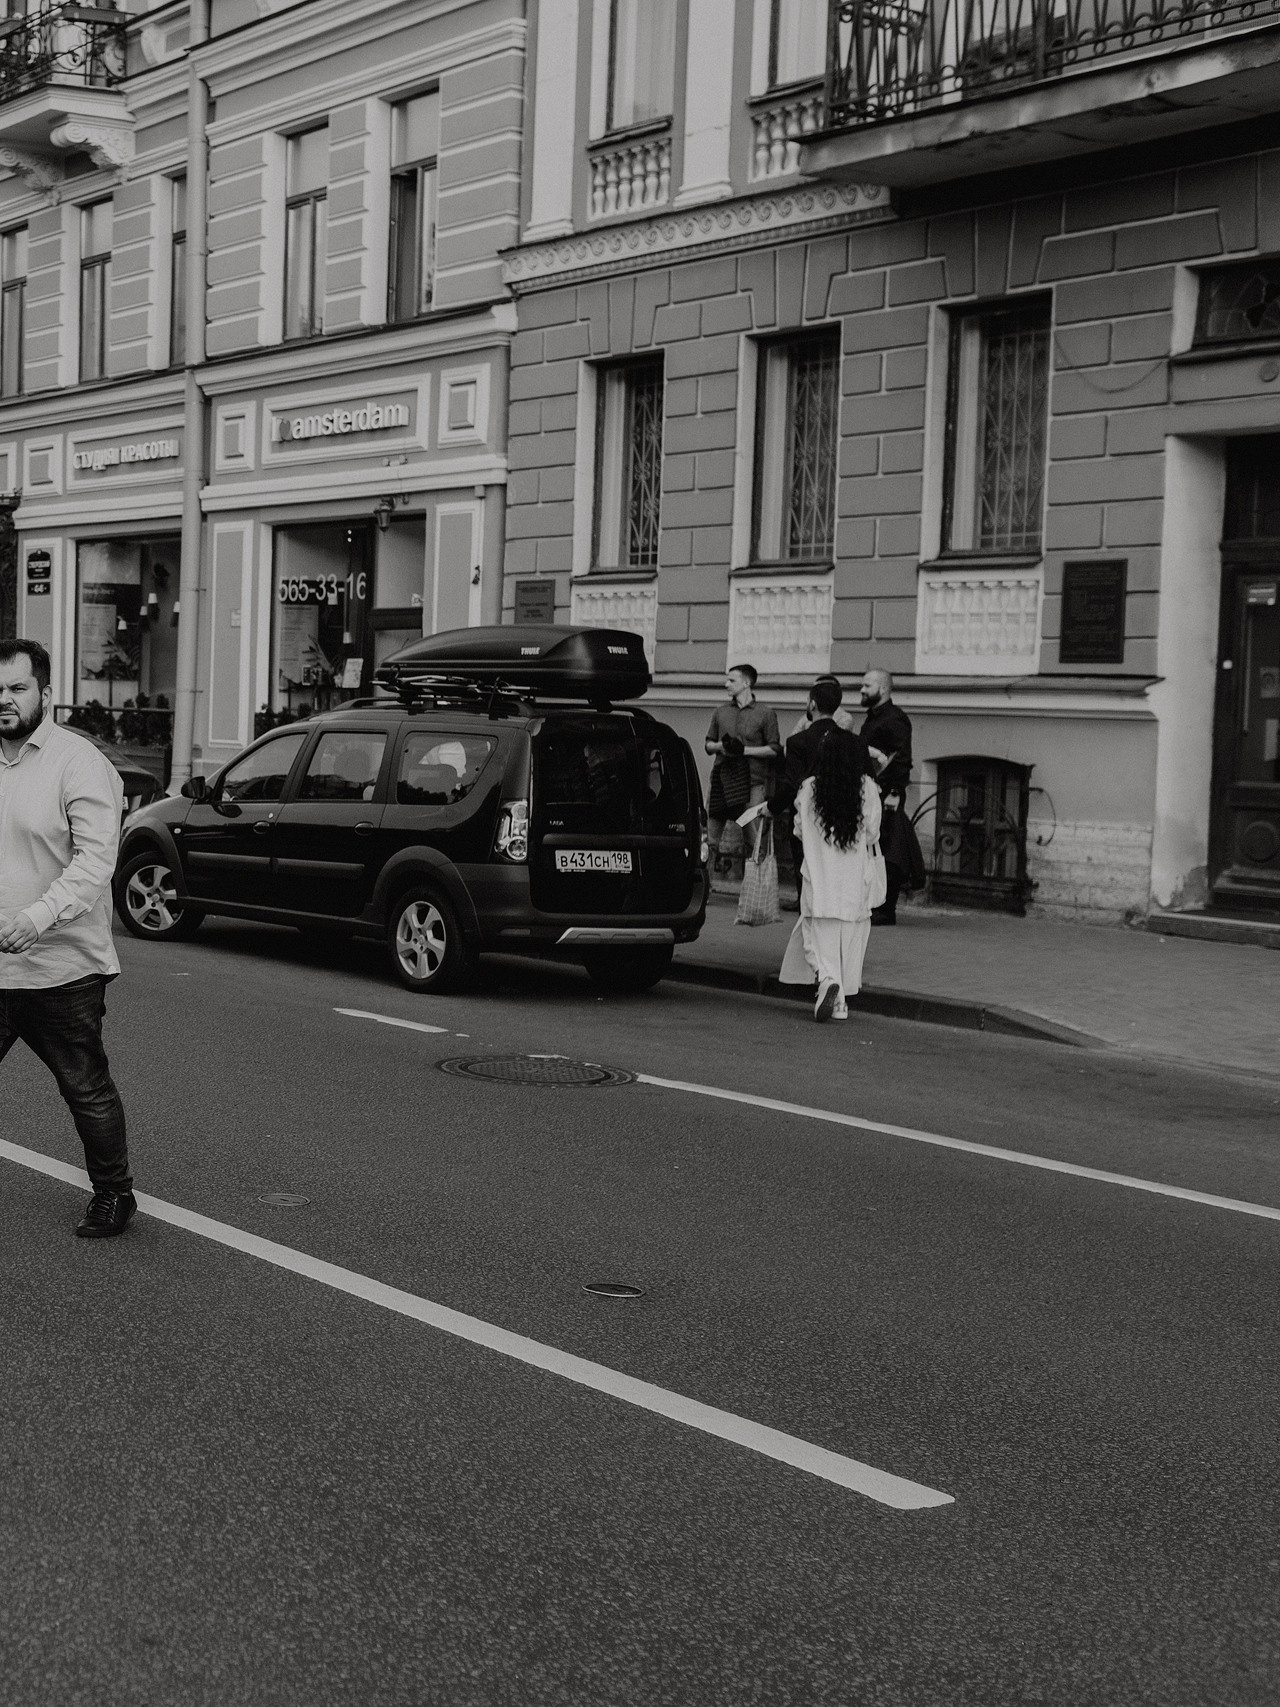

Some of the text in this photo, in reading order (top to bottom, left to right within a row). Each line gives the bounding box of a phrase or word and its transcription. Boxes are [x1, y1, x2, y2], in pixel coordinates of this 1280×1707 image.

[292, 402, 409, 439] amsterdam
[73, 439, 180, 471] СТУДИЯ КРАСОТЫ
[279, 572, 367, 601] 565-33-16
[611, 852, 629, 865] 198
